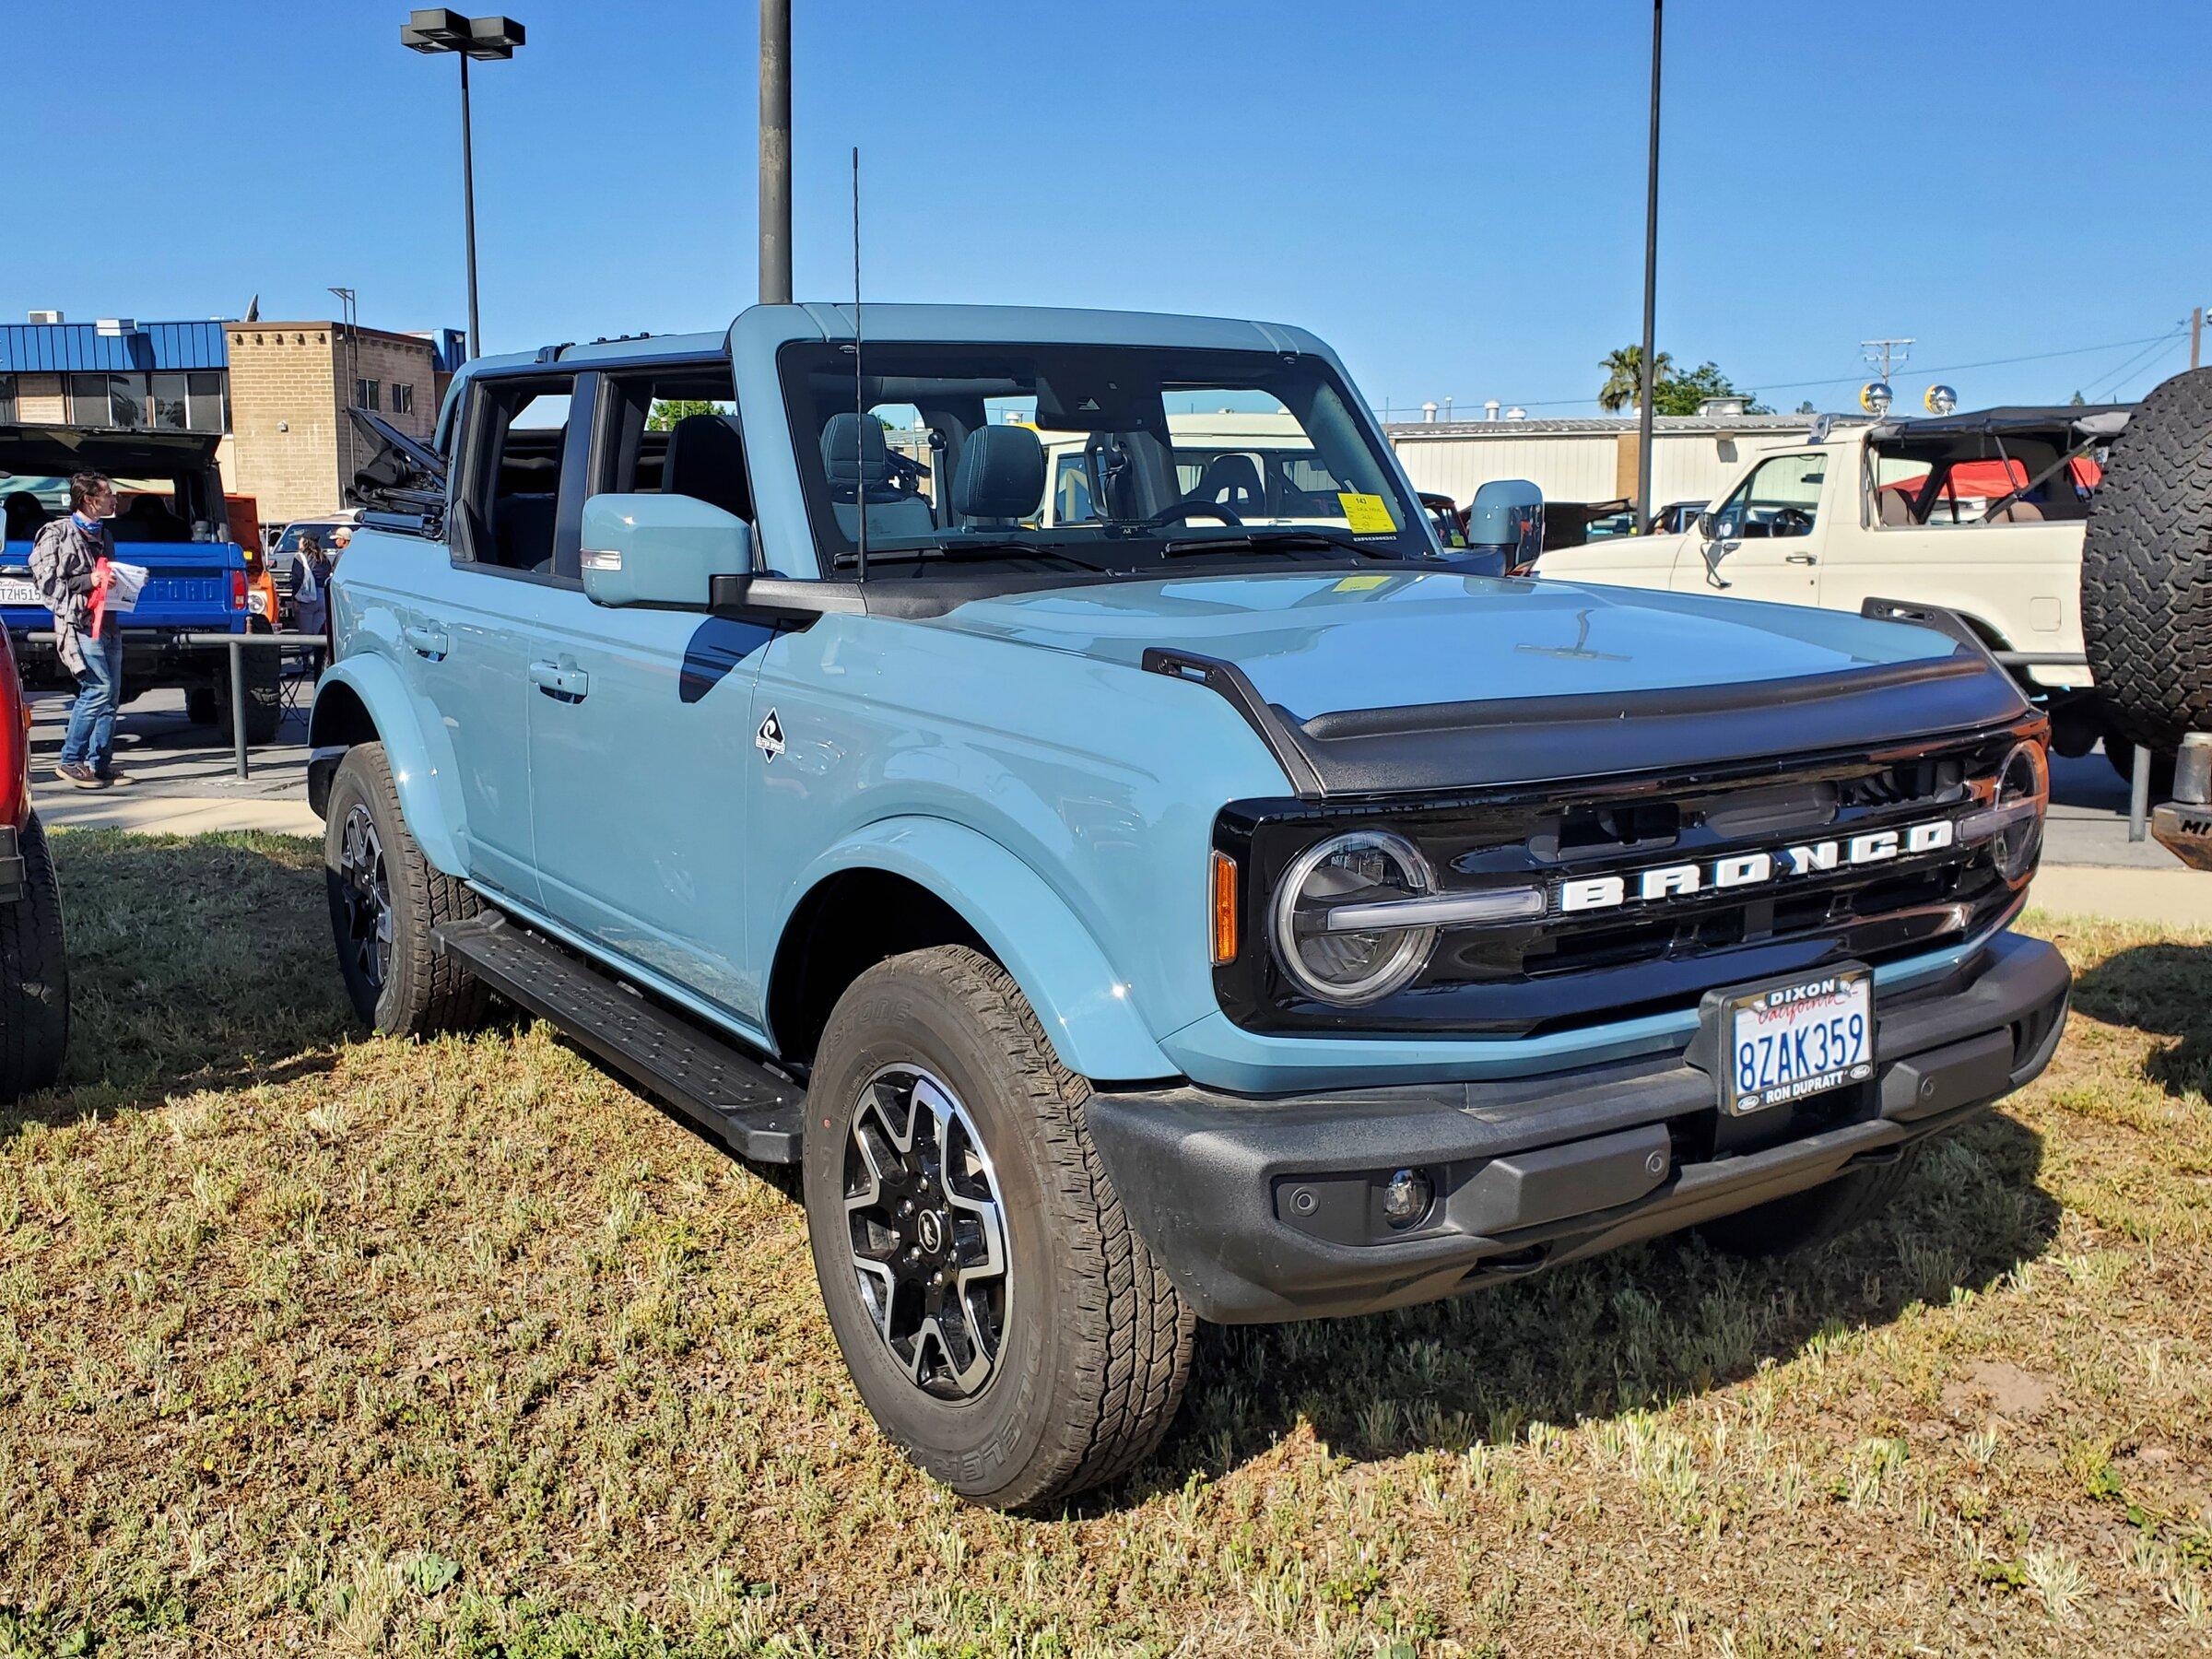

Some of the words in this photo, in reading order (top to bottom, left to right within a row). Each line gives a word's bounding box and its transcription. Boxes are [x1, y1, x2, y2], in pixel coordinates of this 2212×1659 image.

[1562, 820, 1953, 912] BRONCO
[1770, 979, 1835, 1006] DIXON
[1739, 1014, 1864, 1091] 8ZAK359
[1766, 1087, 1791, 1104] RON
[1792, 1071, 1843, 1096] DUPRATT
